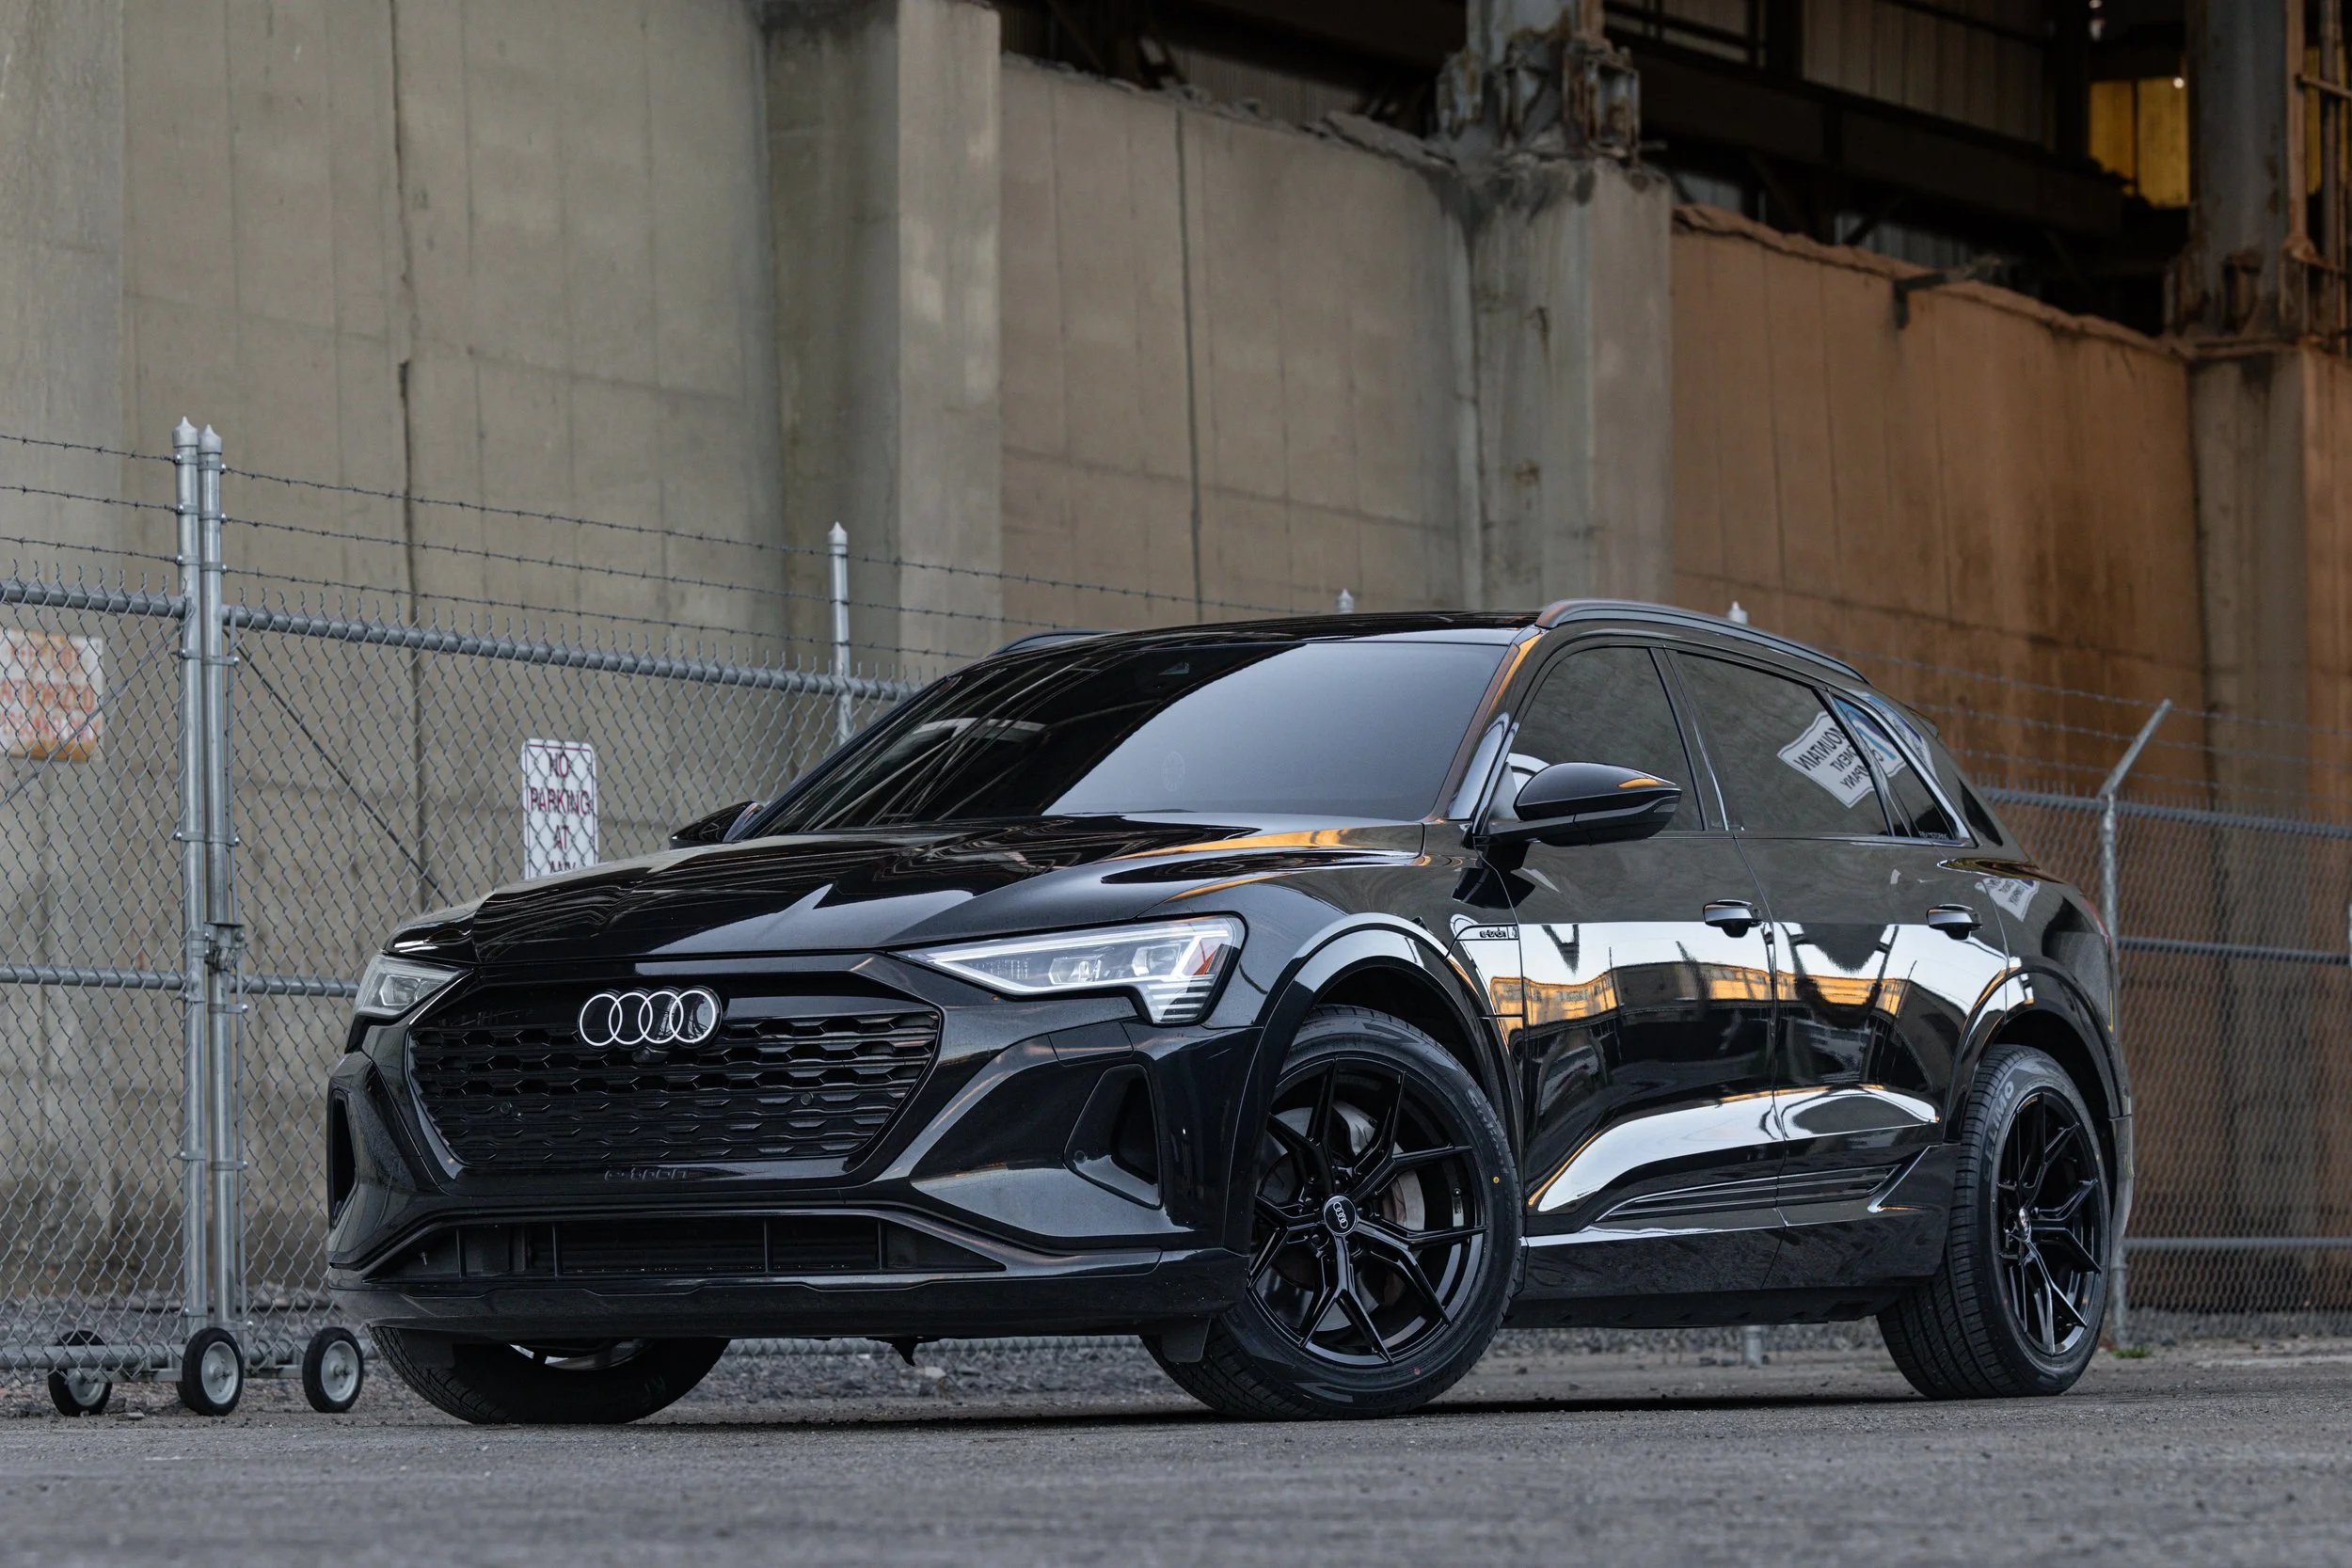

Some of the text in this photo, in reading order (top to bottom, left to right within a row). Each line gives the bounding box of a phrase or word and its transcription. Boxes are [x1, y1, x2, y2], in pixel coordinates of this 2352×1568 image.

[548, 752, 570, 778] NO
[531, 787, 591, 816] PARKING
[553, 825, 569, 850] AT
